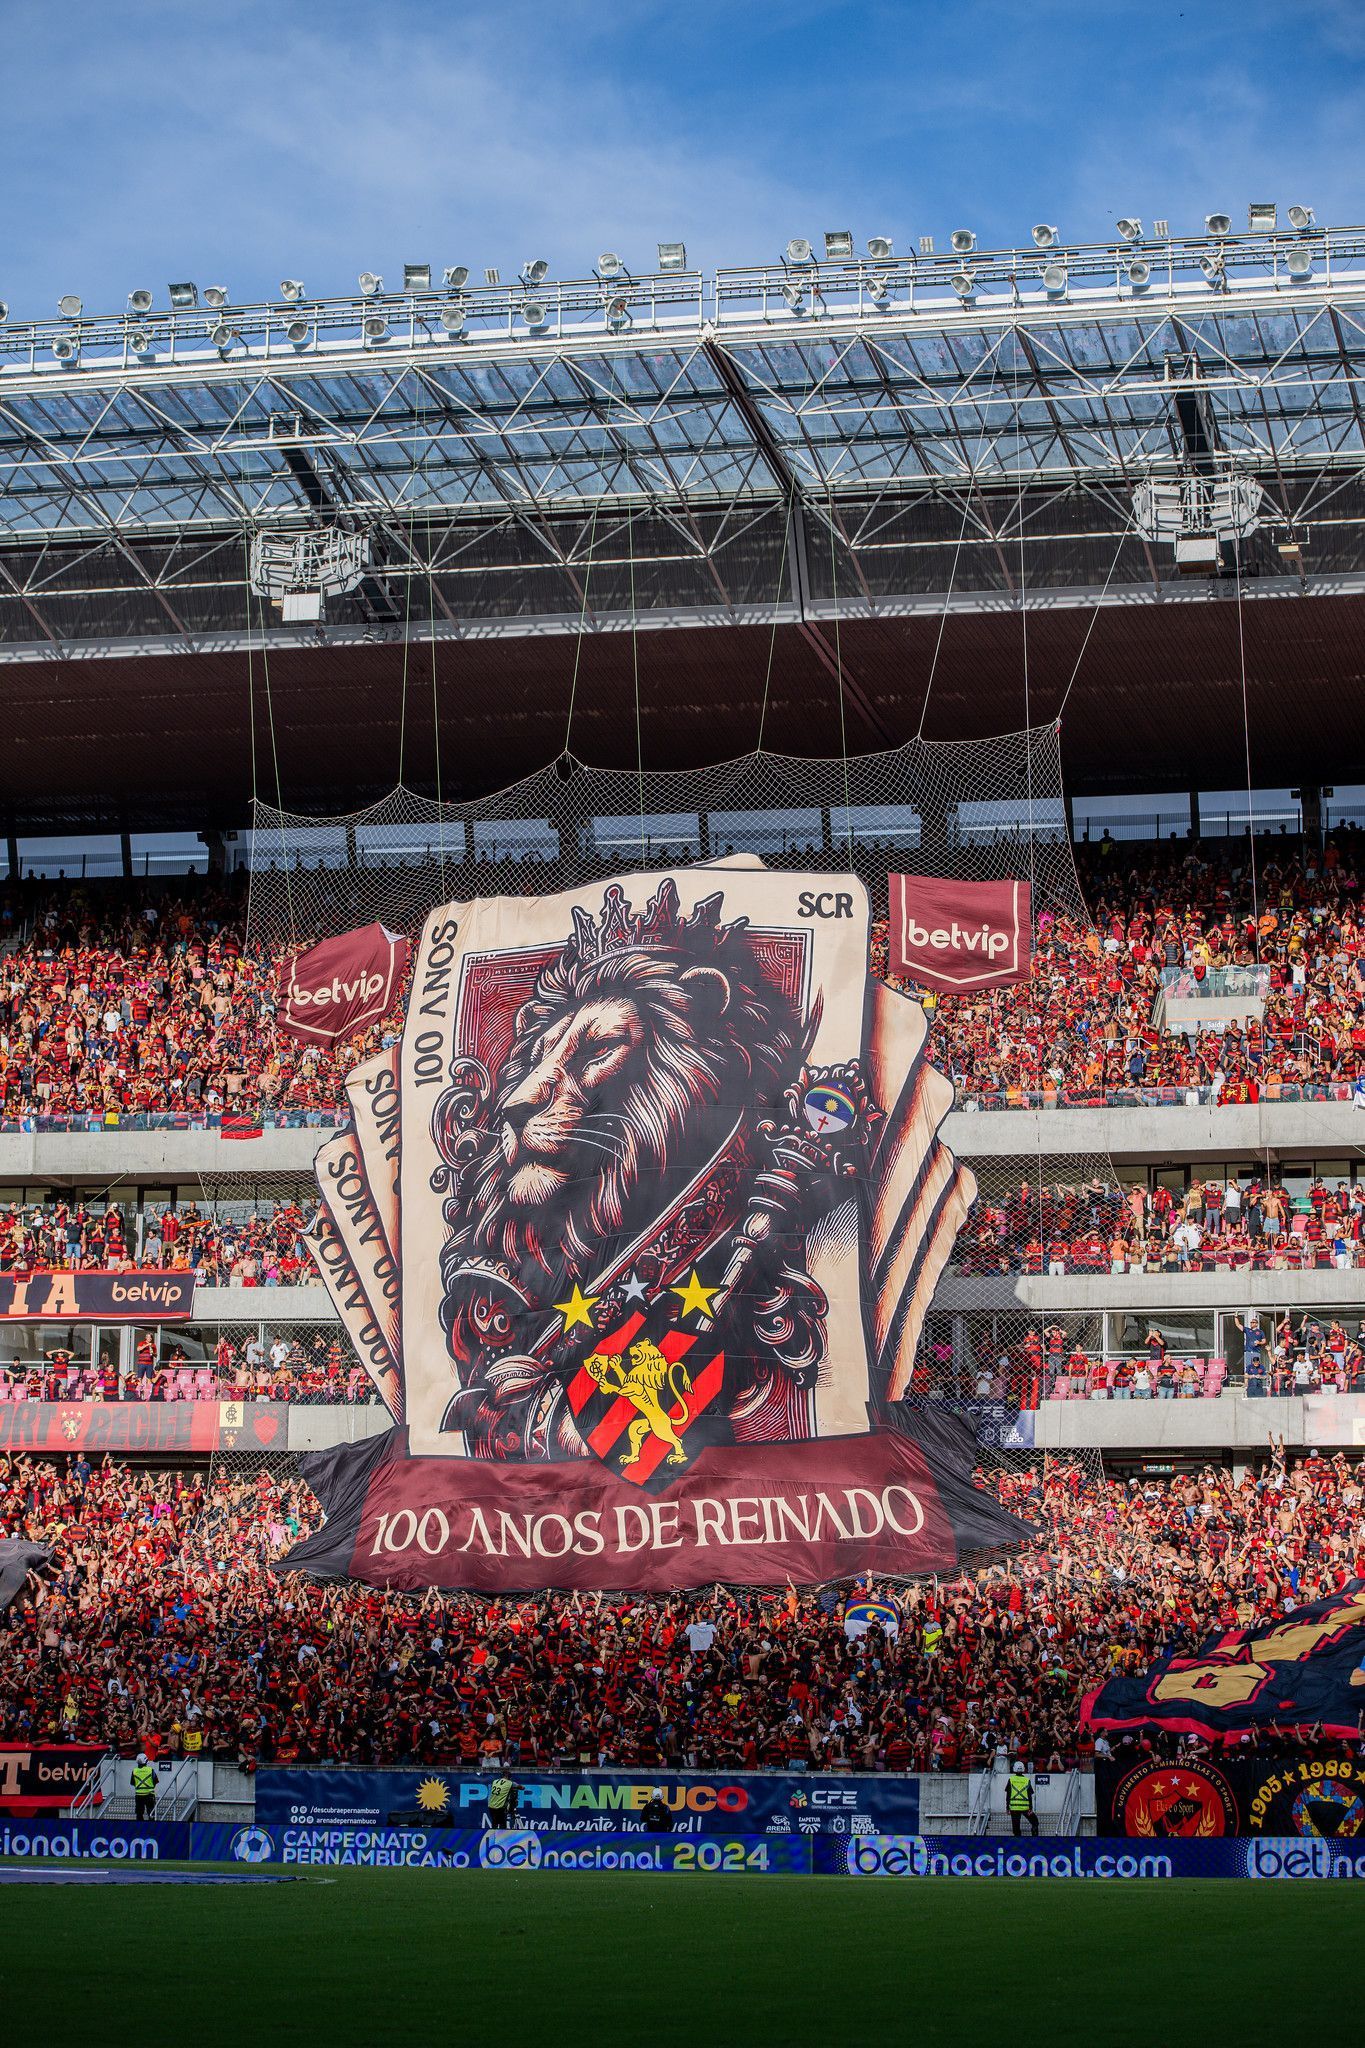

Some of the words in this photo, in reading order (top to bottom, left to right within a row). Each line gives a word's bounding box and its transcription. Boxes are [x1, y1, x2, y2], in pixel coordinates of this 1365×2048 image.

[797, 891, 854, 919] SCR
[909, 919, 1010, 959] betvip
[419, 919, 458, 1018] ANOS
[293, 970, 384, 1006] betvip
[414, 1030, 444, 1089] 100
[1238, 1084, 1248, 1102] Sport
[111, 1281, 182, 1307] betvip
[84, 1402, 194, 1450] RECIFE
[369, 1507, 451, 1557] 100
[456, 1507, 605, 1559] ANOS
[612, 1500, 685, 1553] DE
[690, 1485, 925, 1547] REINADO
[459, 1783, 750, 1813] PRNAMBUCO
[491, 1786, 502, 1796] 23
[811, 1790, 858, 1805] CFE
[1118, 1767, 1148, 1807] MOVIMENTO
[1193, 1763, 1211, 1776] ELAS
[1219, 1787, 1233, 1813] SPORT
[1249, 1774, 1283, 1829] 1905
[1297, 1759, 1353, 1781] 1988
[0, 1828, 159, 1860] ional.com
[283, 1830, 428, 1850] CAMPEONATO
[282, 1848, 470, 1869] PERNAMBUCANO
[673, 1841, 770, 1871] 2024
